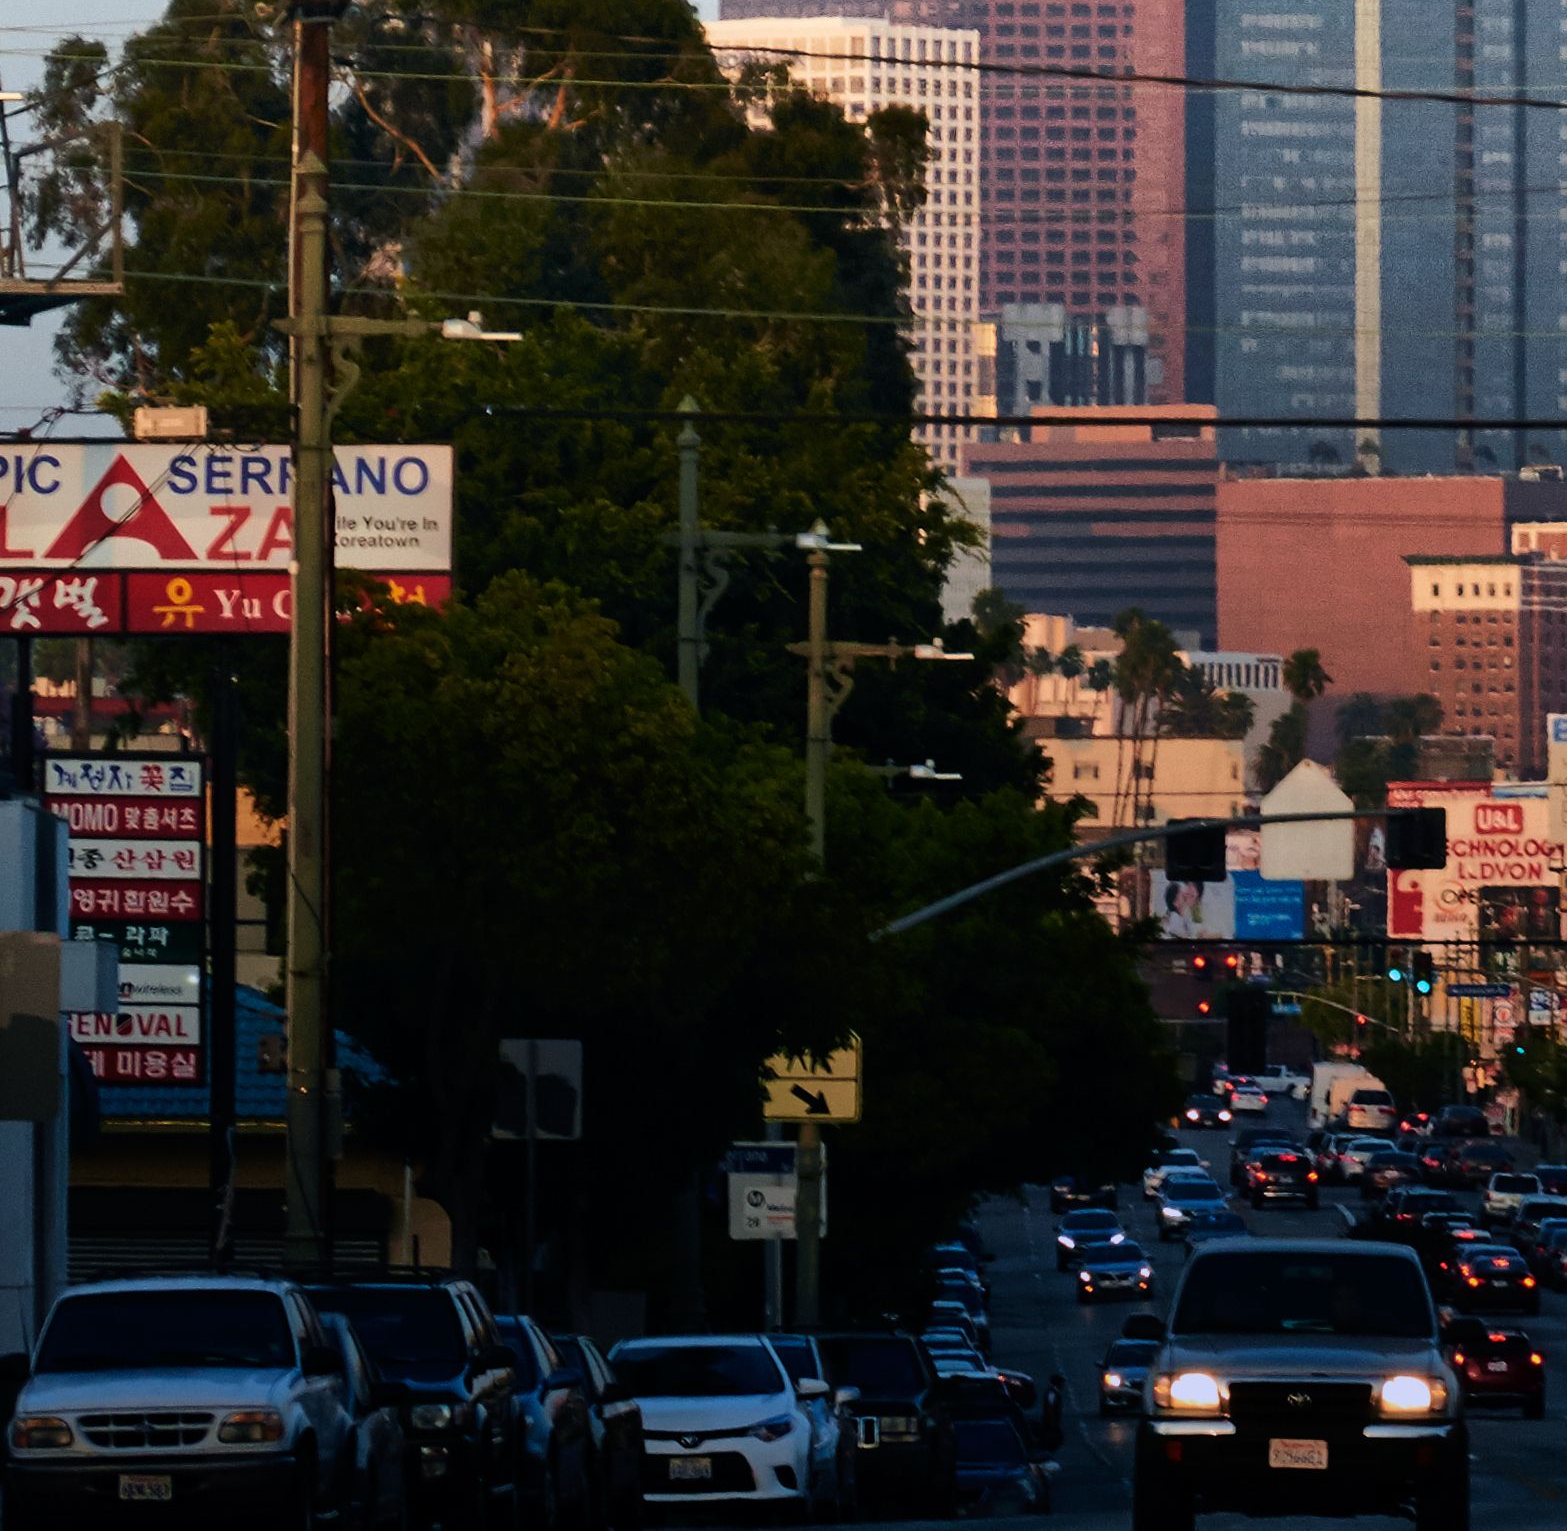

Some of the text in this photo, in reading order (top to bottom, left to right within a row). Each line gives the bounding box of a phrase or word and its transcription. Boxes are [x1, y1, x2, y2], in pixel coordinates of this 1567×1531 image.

[153, 577, 205, 628] 유
[213, 589, 262, 620] Yu
[117, 1050, 197, 1080] 미용실
